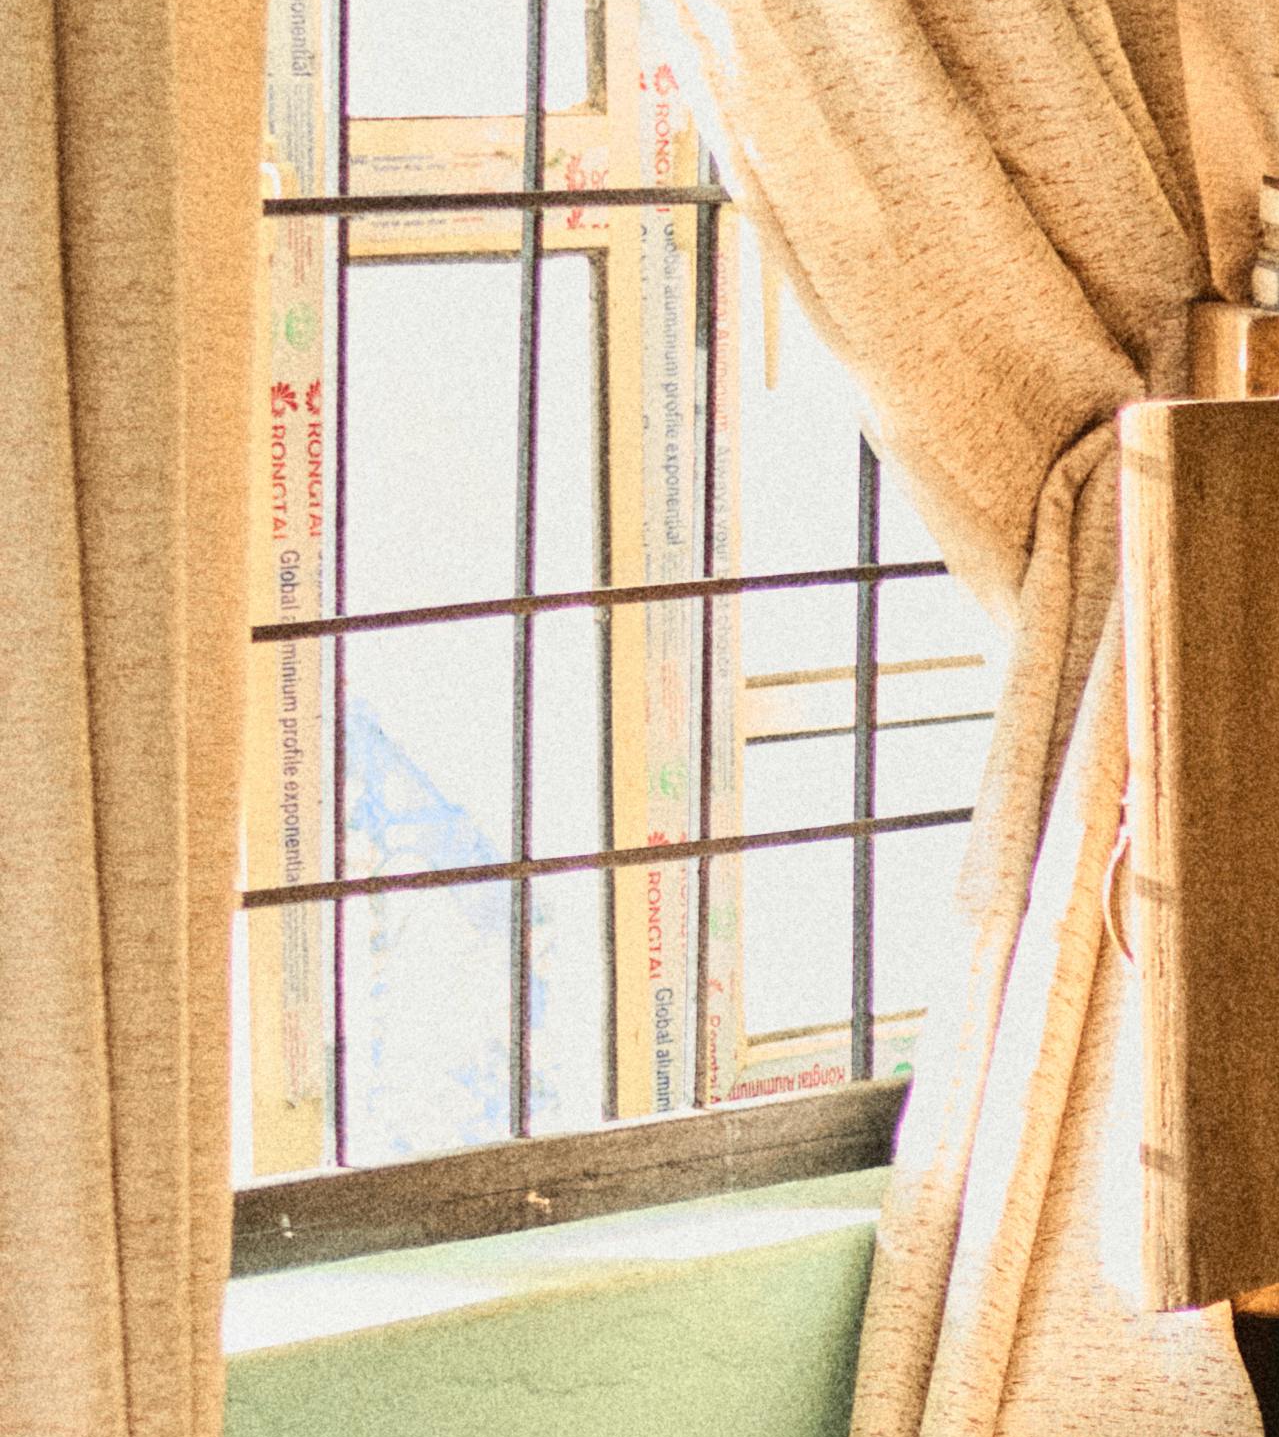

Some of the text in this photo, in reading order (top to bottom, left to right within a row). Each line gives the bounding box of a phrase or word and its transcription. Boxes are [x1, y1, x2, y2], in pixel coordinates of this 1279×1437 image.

[280, 550, 308, 777] Global profile
[656, 987, 674, 1044] Global
